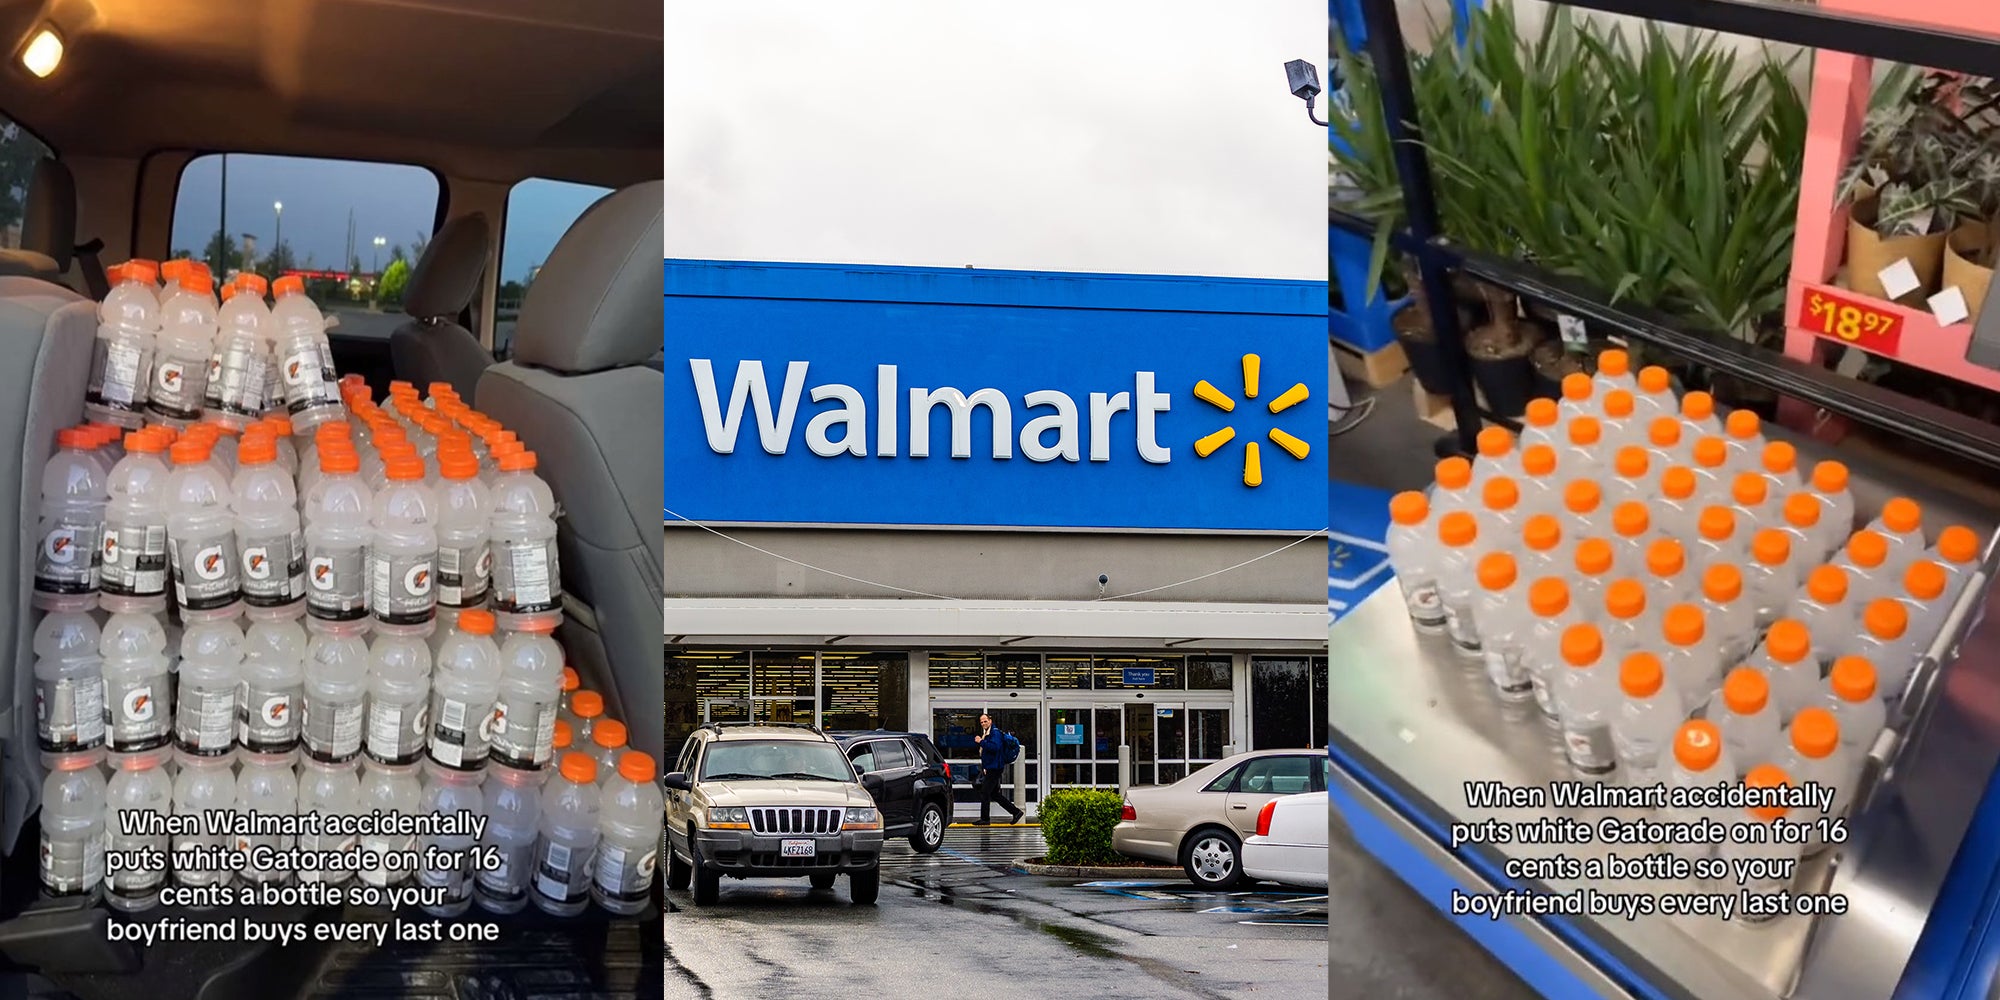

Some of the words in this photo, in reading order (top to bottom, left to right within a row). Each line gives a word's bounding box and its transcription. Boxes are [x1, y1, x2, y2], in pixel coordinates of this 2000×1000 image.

[689, 358, 1171, 464] Walmart
[193, 545, 226, 580] G
[243, 546, 271, 580] G
[309, 556, 334, 591] G
[123, 686, 154, 722] G
[261, 694, 291, 728] G
